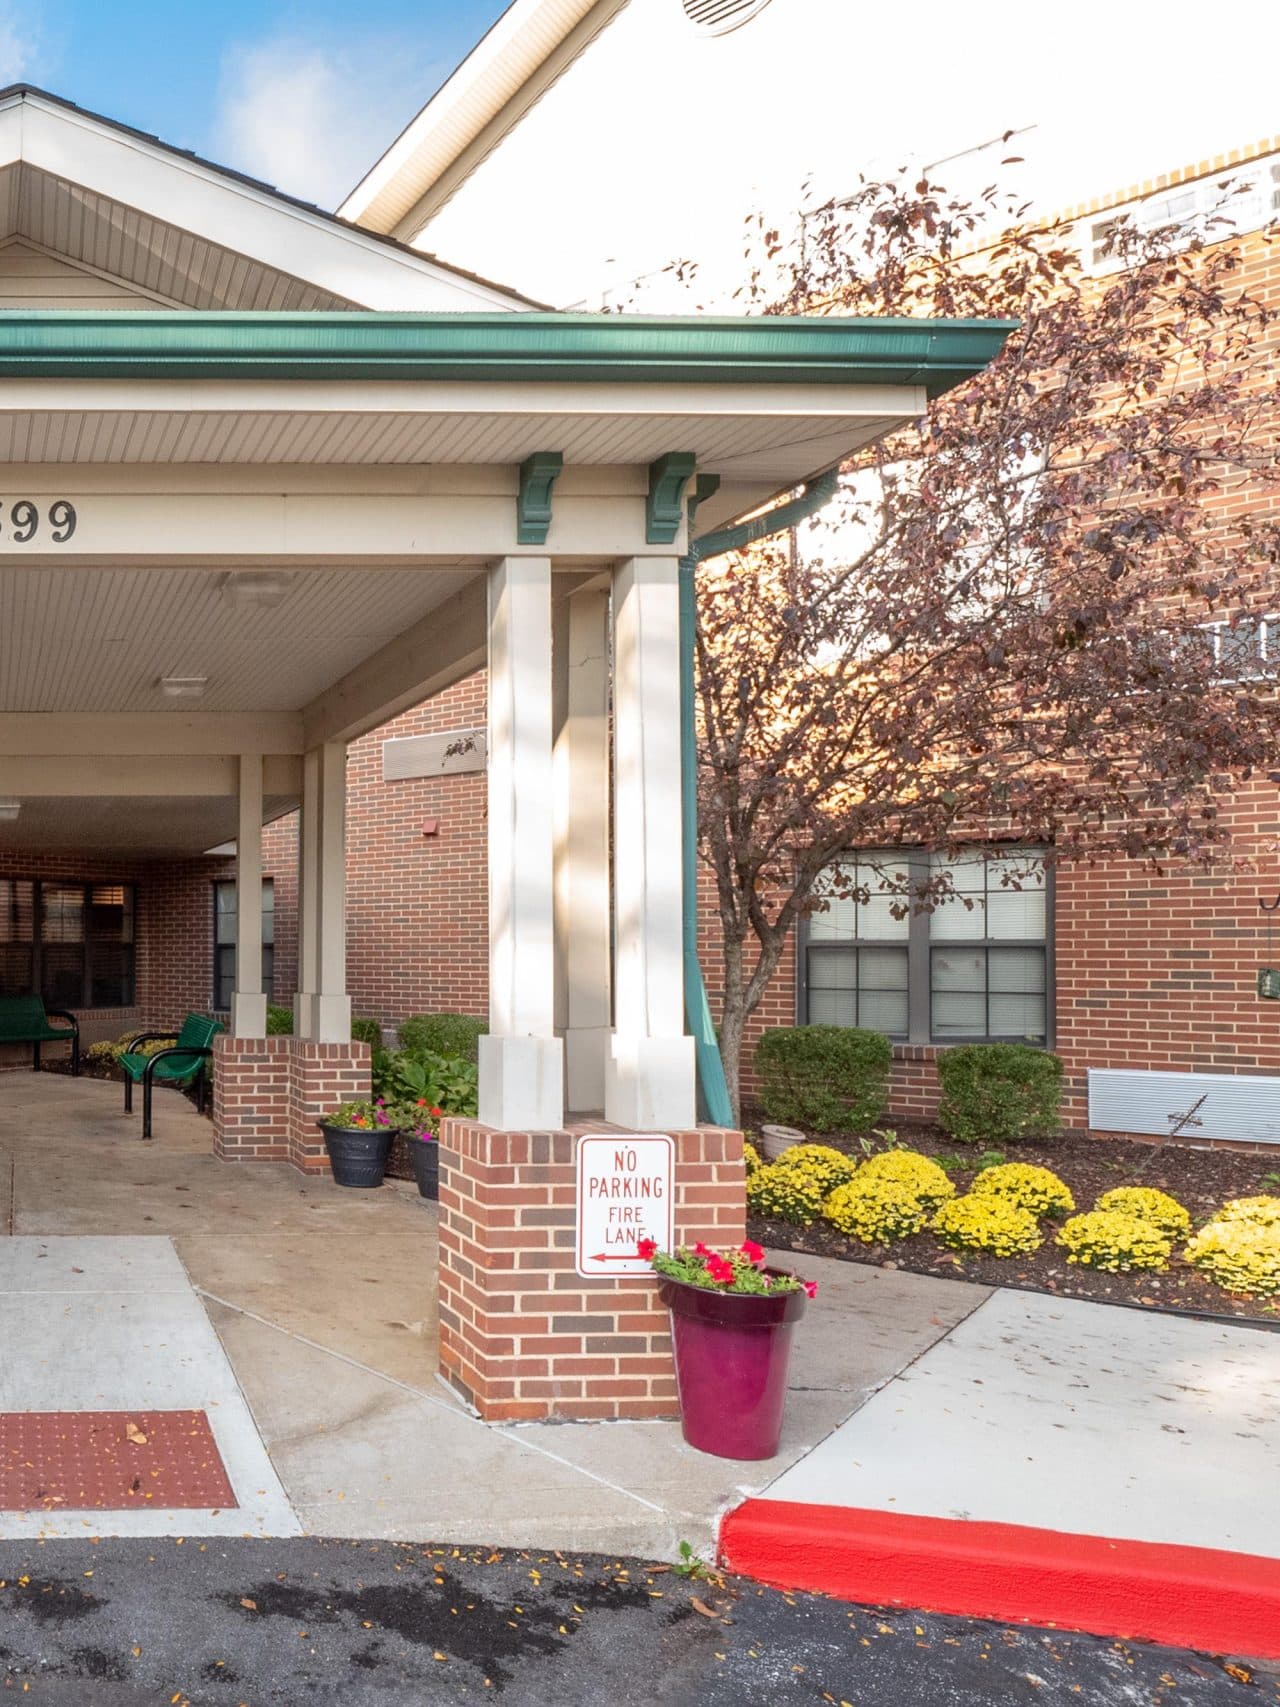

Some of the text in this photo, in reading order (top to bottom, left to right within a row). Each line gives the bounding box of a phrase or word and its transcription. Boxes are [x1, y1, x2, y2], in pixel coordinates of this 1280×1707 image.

[614, 1150, 637, 1172] NO
[589, 1176, 663, 1199] PARKING
[609, 1206, 644, 1223] FIRE
[605, 1227, 648, 1244] LANE
